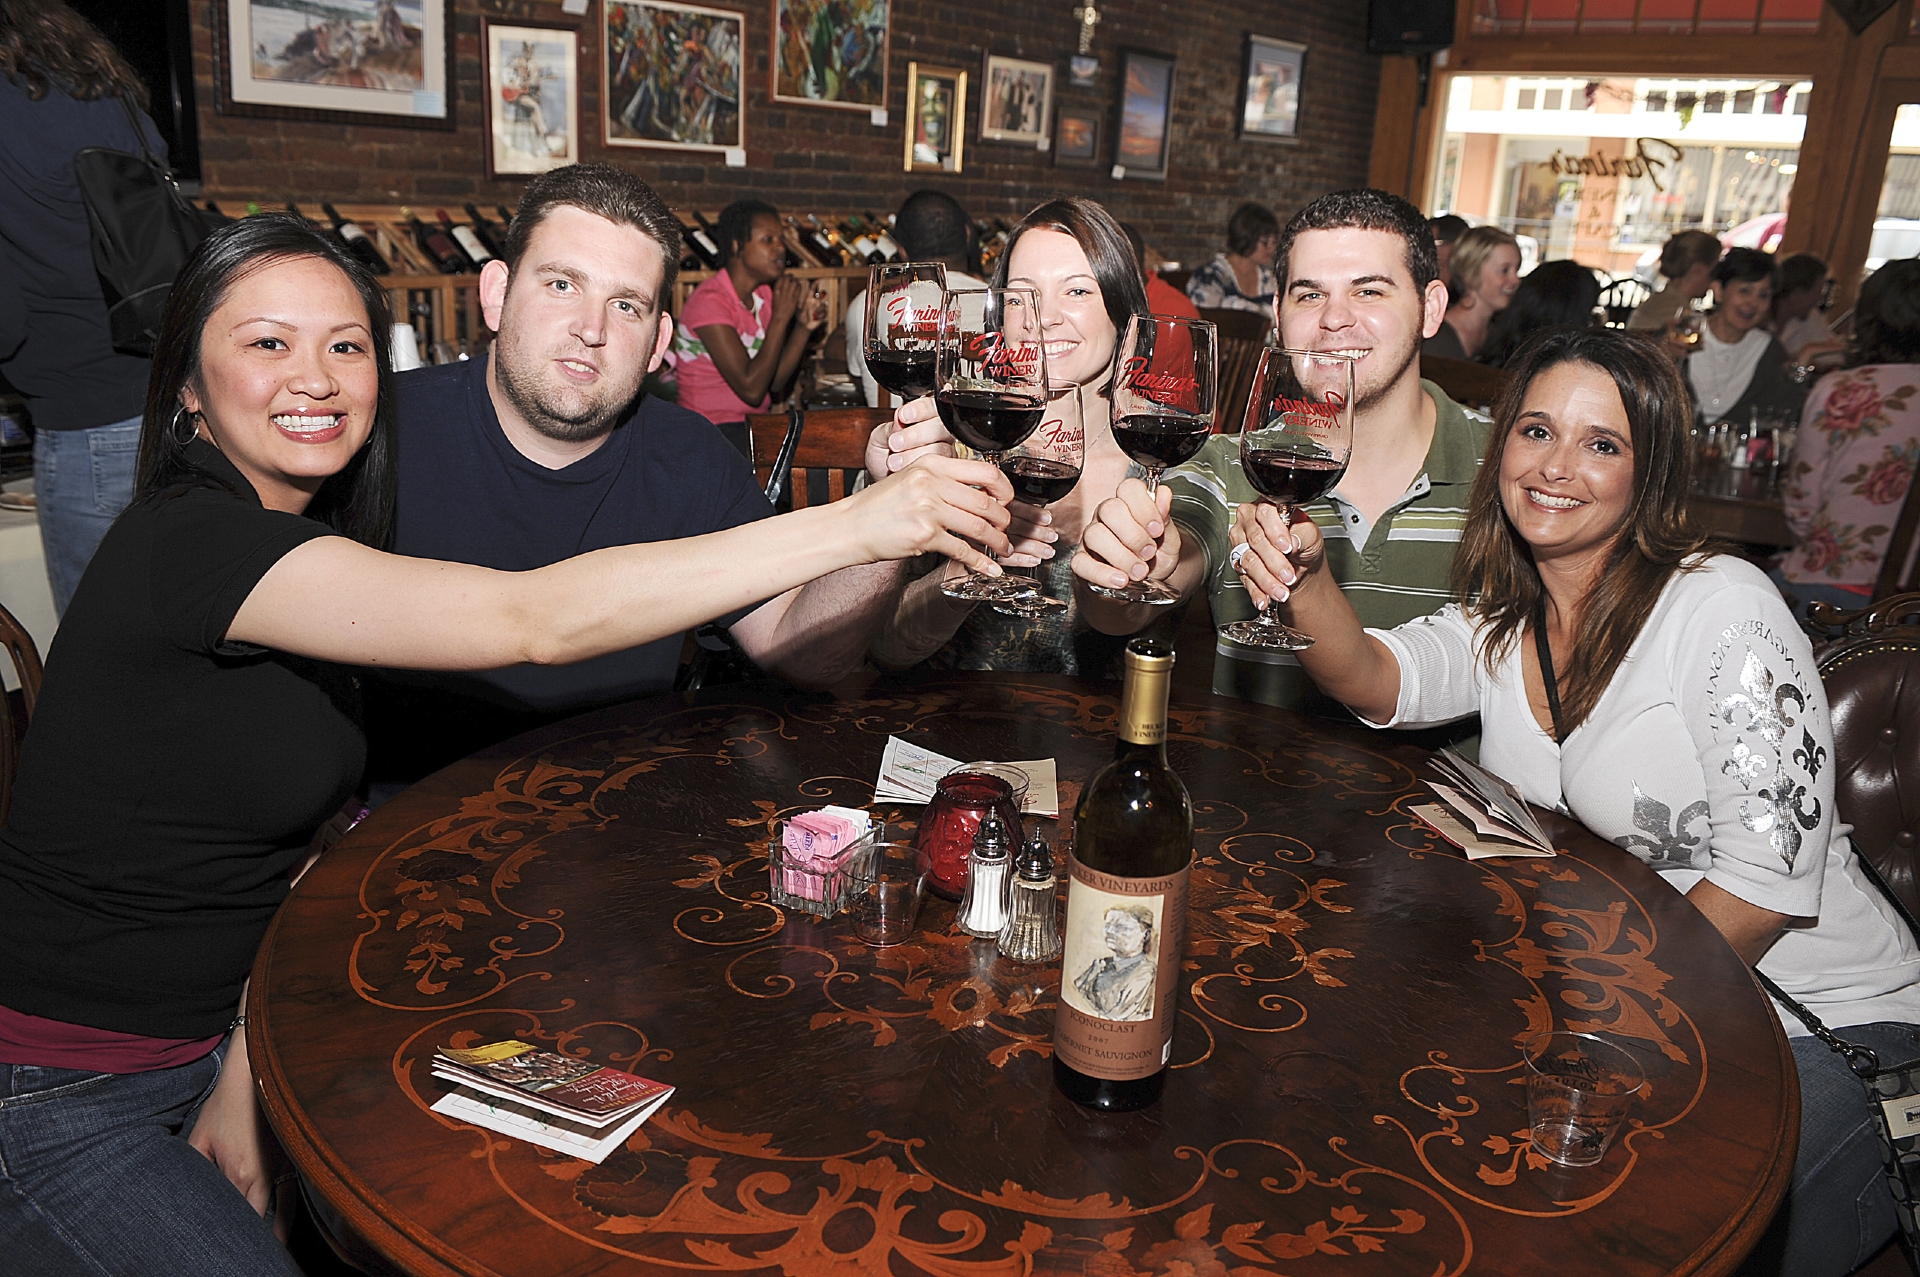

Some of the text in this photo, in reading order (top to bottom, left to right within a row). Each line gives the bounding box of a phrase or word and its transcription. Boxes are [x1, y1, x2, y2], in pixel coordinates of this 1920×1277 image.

[989, 364, 1038, 378] WINERY
[1123, 356, 1200, 391] Farina's
[1131, 386, 1182, 404] WINERY
[1099, 877, 1174, 893] VINEYARDS
[1070, 1010, 1137, 1034] ICONOCLAST
[1088, 1034, 1109, 1045] 2007
[1094, 1047, 1154, 1061] SAUVIGNON
